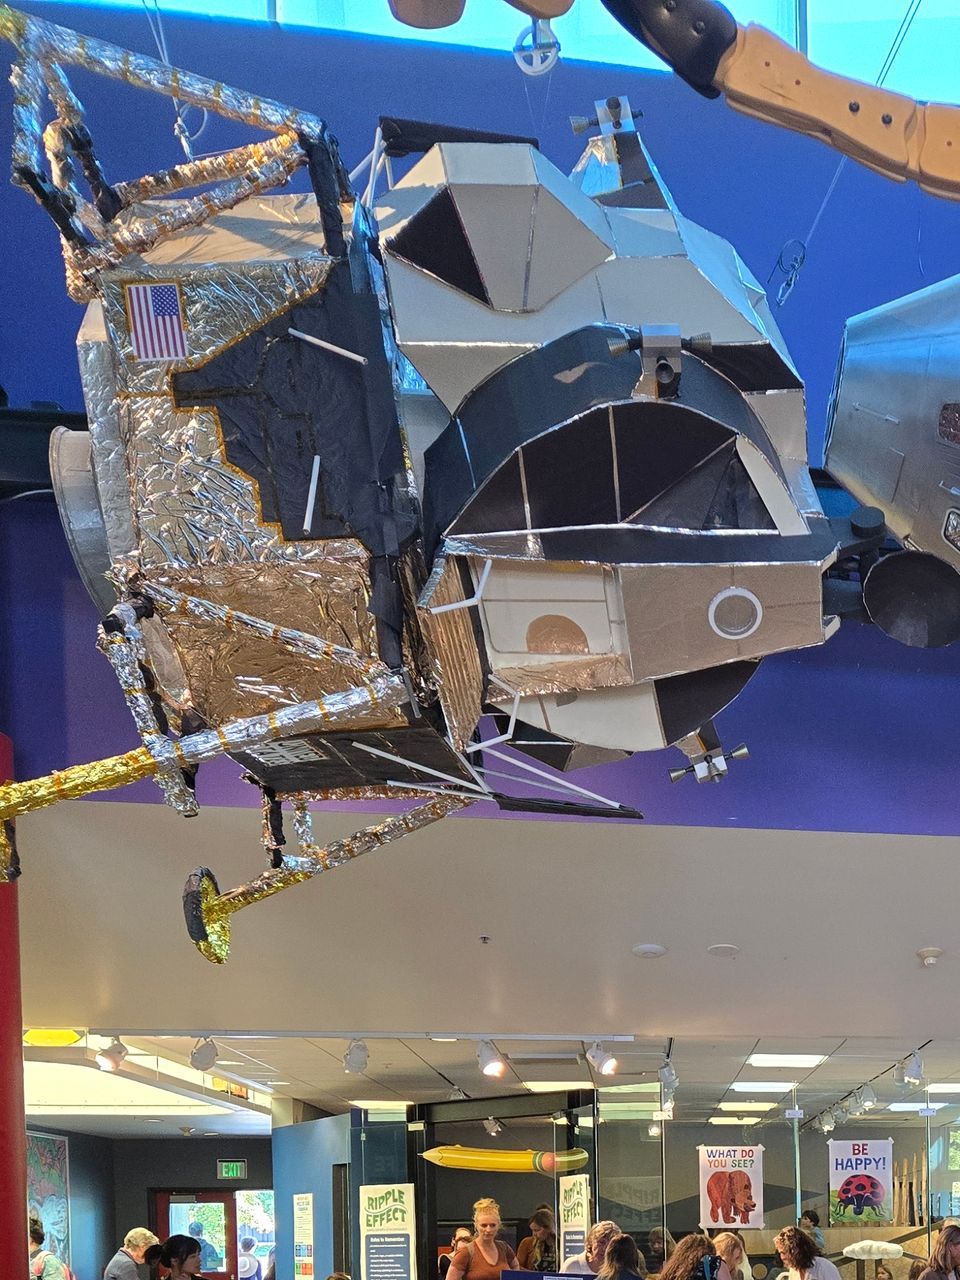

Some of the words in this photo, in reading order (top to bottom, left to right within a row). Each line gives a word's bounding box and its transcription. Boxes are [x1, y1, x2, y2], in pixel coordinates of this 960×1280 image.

[706, 1149, 738, 1158] WHAT
[741, 1149, 754, 1158] DO
[852, 1143, 869, 1156] BE
[222, 1162, 240, 1177] EXIT
[707, 1159, 727, 1168] YOU
[731, 1158, 754, 1168] SEE?
[835, 1156, 887, 1171] HAPPY!
[563, 1179, 583, 1204] RIPPLE
[367, 1188, 405, 1211] RIPPLE
[366, 1207, 407, 1228] EFFECT
[563, 1200, 584, 1223] EFFECT
